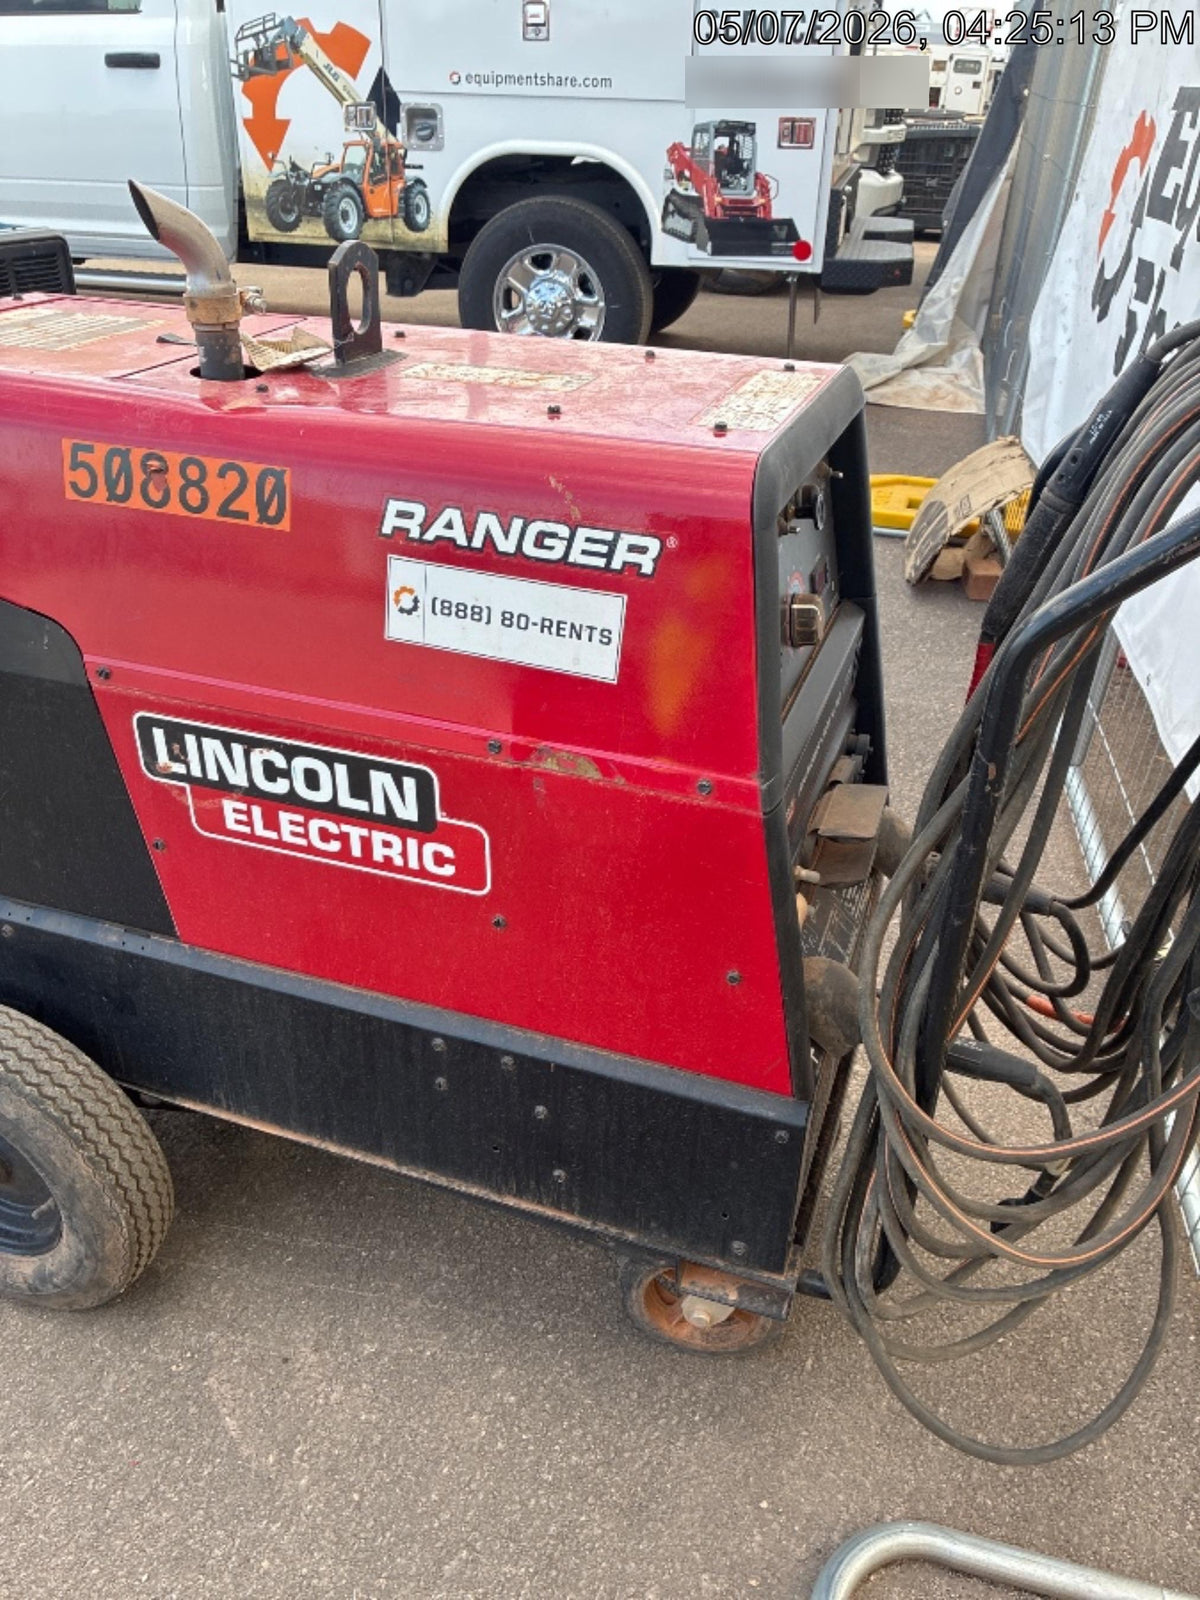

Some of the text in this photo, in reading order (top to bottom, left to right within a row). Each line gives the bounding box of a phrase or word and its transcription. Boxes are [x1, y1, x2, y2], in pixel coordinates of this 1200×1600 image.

[465, 71, 613, 89] equipmentshare.com
[68, 442, 288, 526] 508820
[430, 596, 613, 646] (888) 80-RENTS
[151, 726, 419, 822] LINCOLN
[222, 799, 457, 877] ELECTRIC
